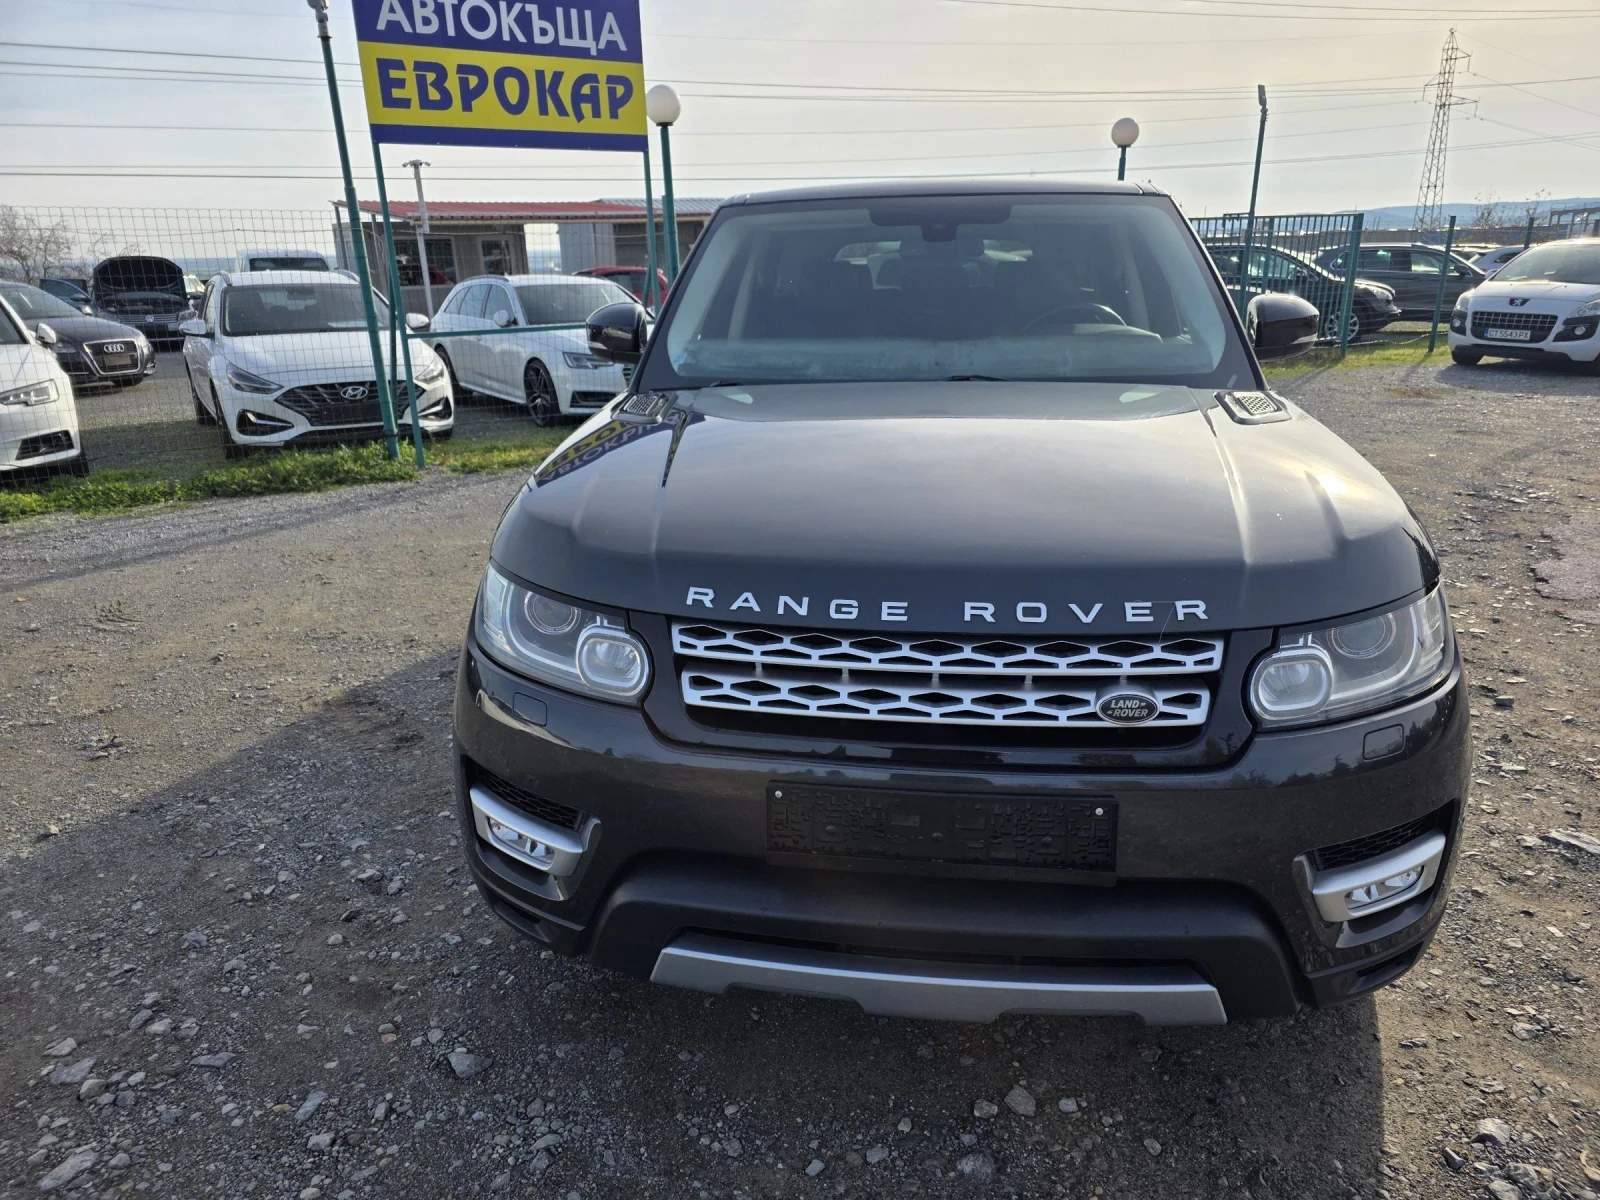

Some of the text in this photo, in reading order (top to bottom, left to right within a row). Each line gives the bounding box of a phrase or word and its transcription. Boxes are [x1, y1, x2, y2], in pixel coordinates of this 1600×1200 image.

[376, 0, 627, 55] АВТОКЪЩА
[376, 58, 634, 123] ЕВРОКАР
[686, 586, 1209, 623] RANGE ROVER
[1110, 699, 1140, 709] LAND
[1112, 708, 1149, 717] ROVER
